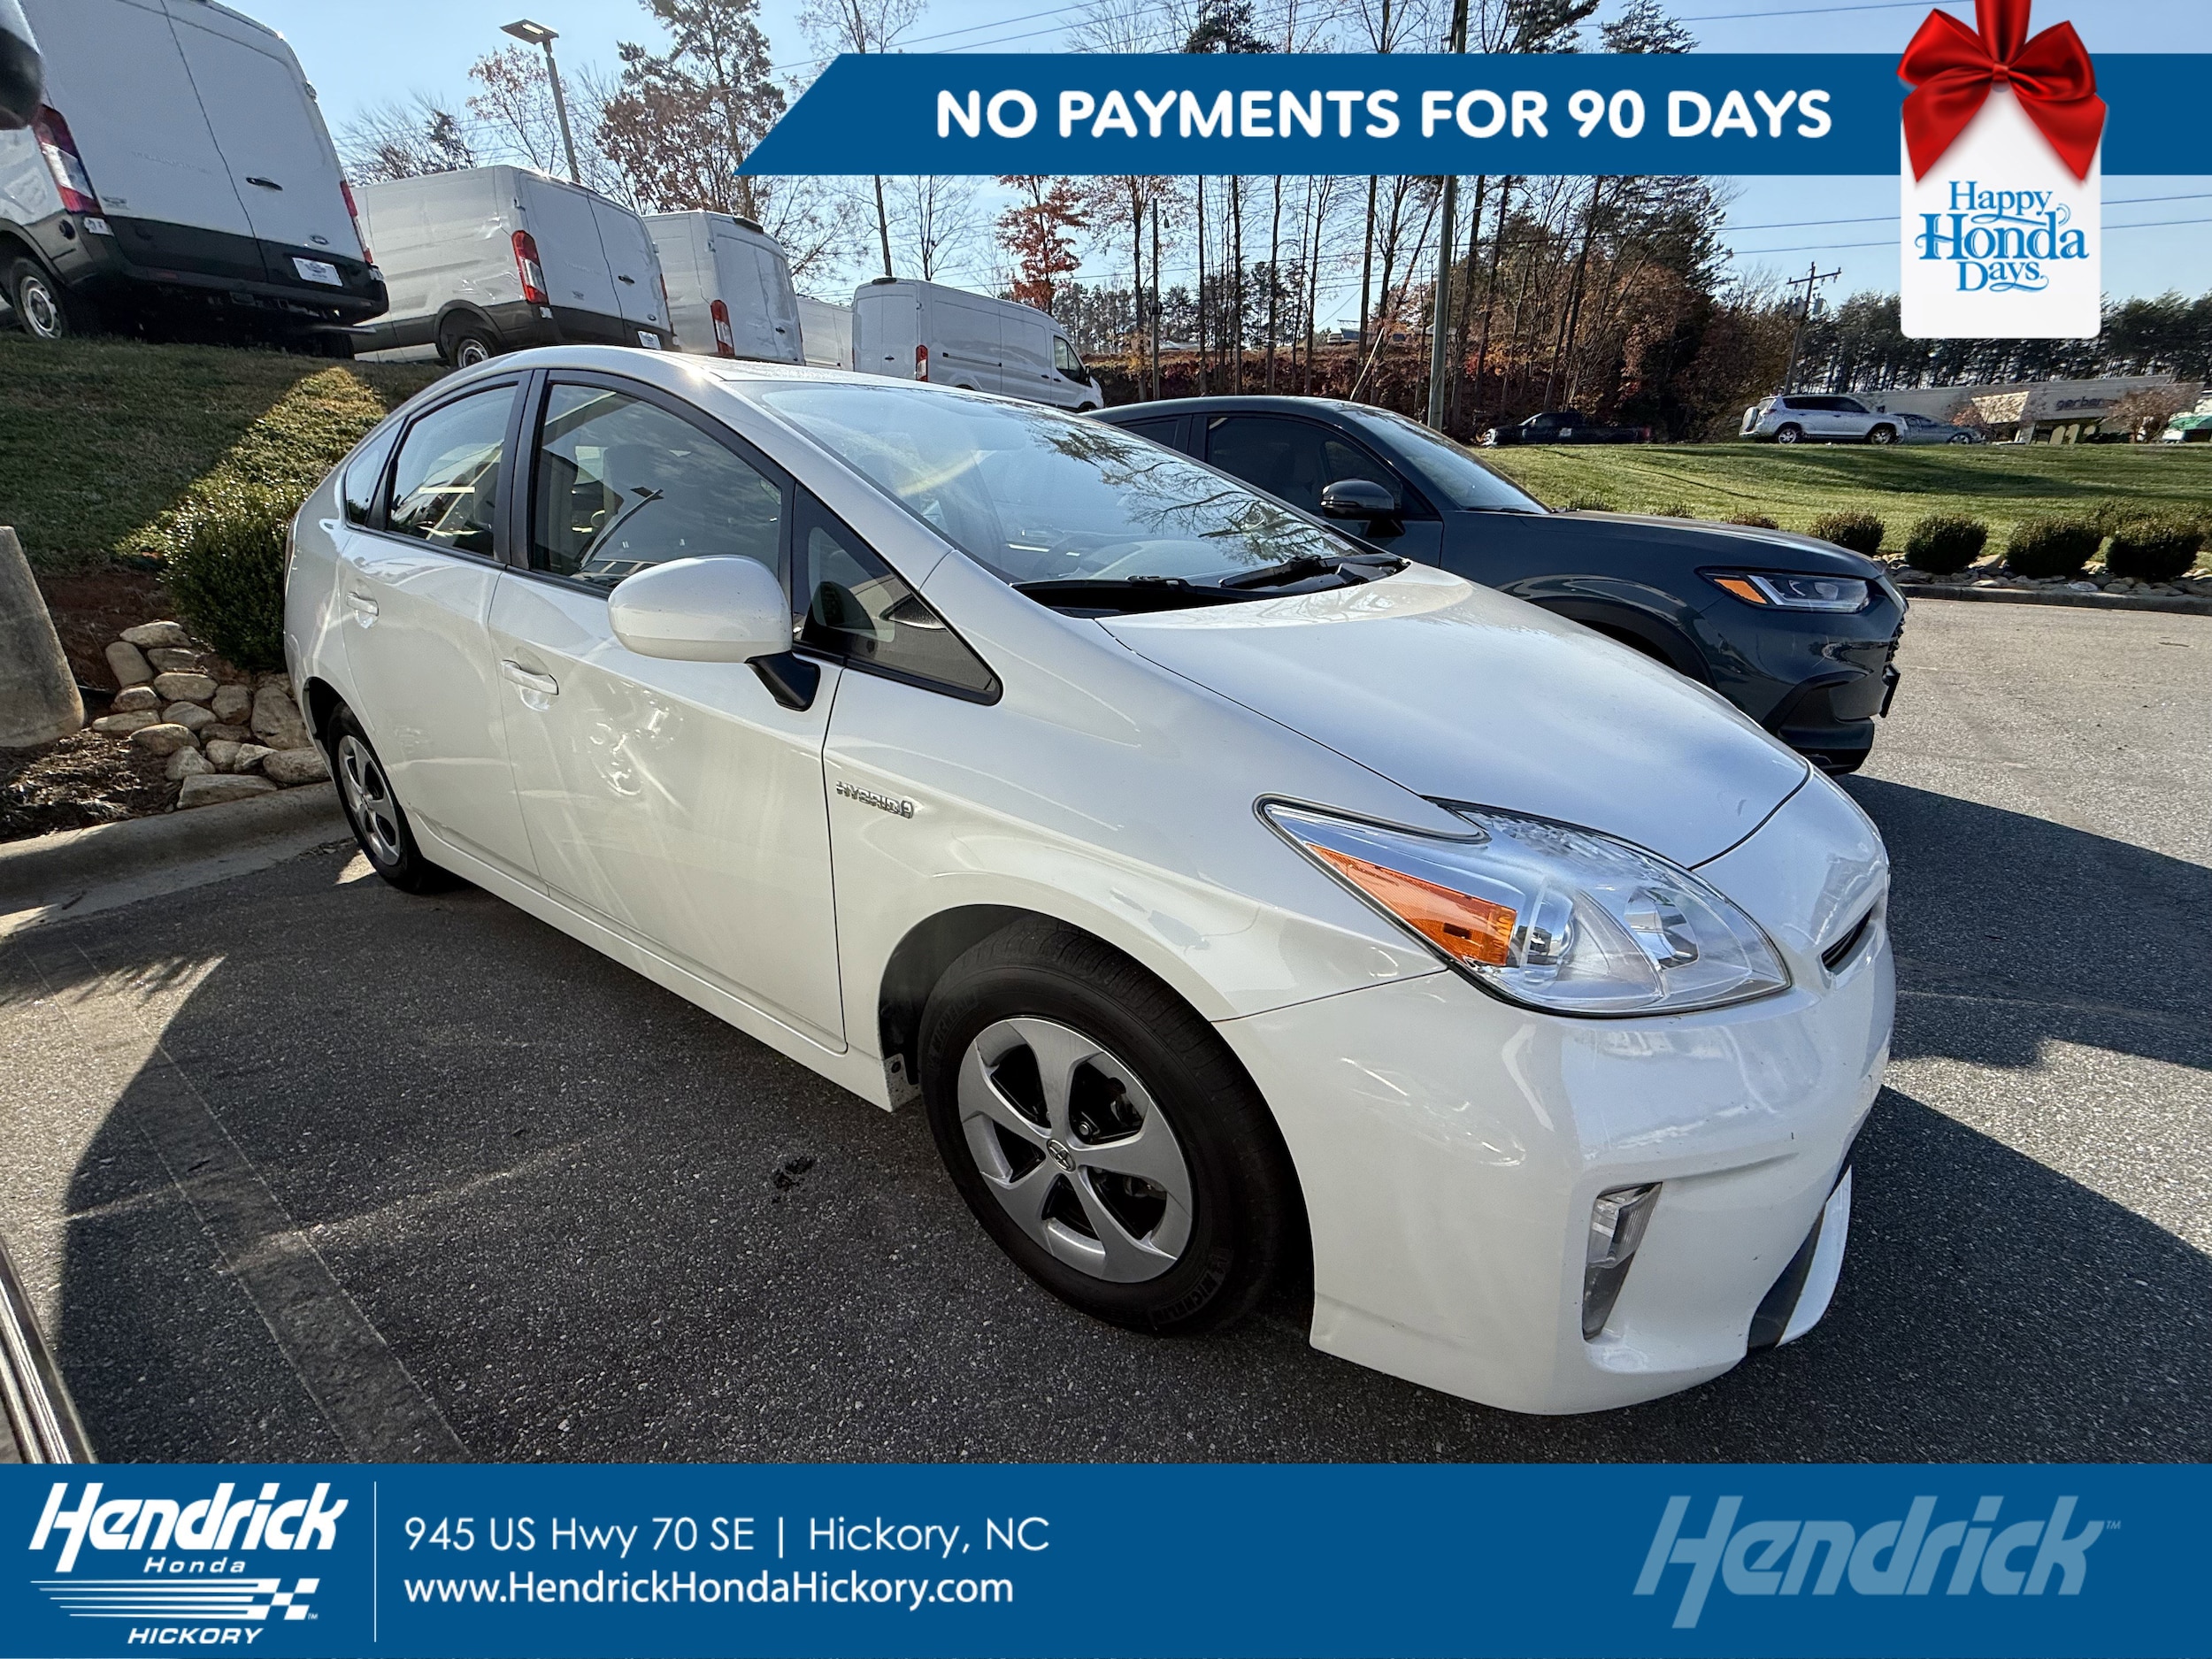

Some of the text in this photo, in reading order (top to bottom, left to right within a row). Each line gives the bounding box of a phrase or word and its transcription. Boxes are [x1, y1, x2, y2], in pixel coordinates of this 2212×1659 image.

[2055, 396, 2105, 411] gerber
[835, 780, 901, 815] HYBRID
[1147, 1269, 1224, 1325] MICHELIN
